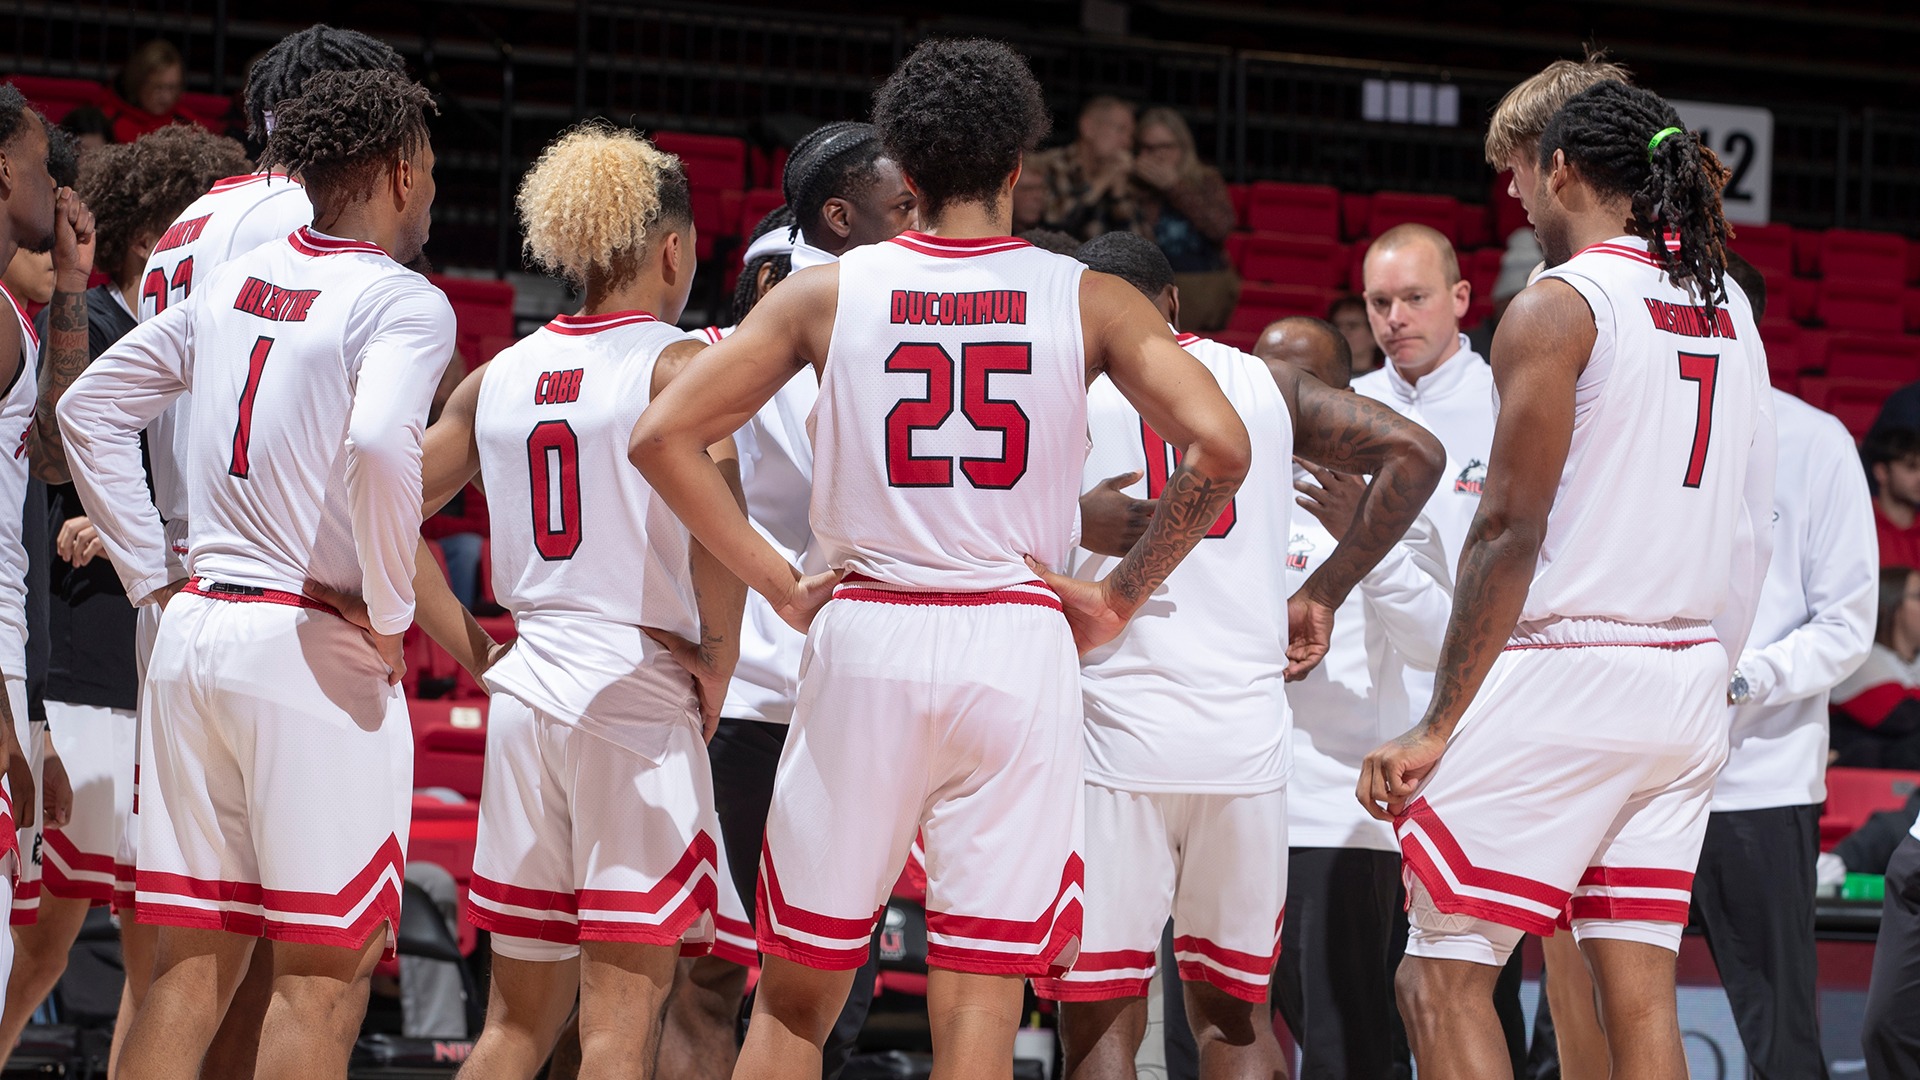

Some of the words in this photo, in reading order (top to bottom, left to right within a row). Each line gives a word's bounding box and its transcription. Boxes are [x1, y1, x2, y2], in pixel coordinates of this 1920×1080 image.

[1700, 127, 1755, 201] 2
[890, 289, 1027, 326] DUCOMMUN
[228, 334, 275, 480] 1
[534, 368, 584, 405] COBB
[884, 341, 1032, 490] 25
[1677, 350, 1720, 489] 7
[526, 419, 583, 561] 0
